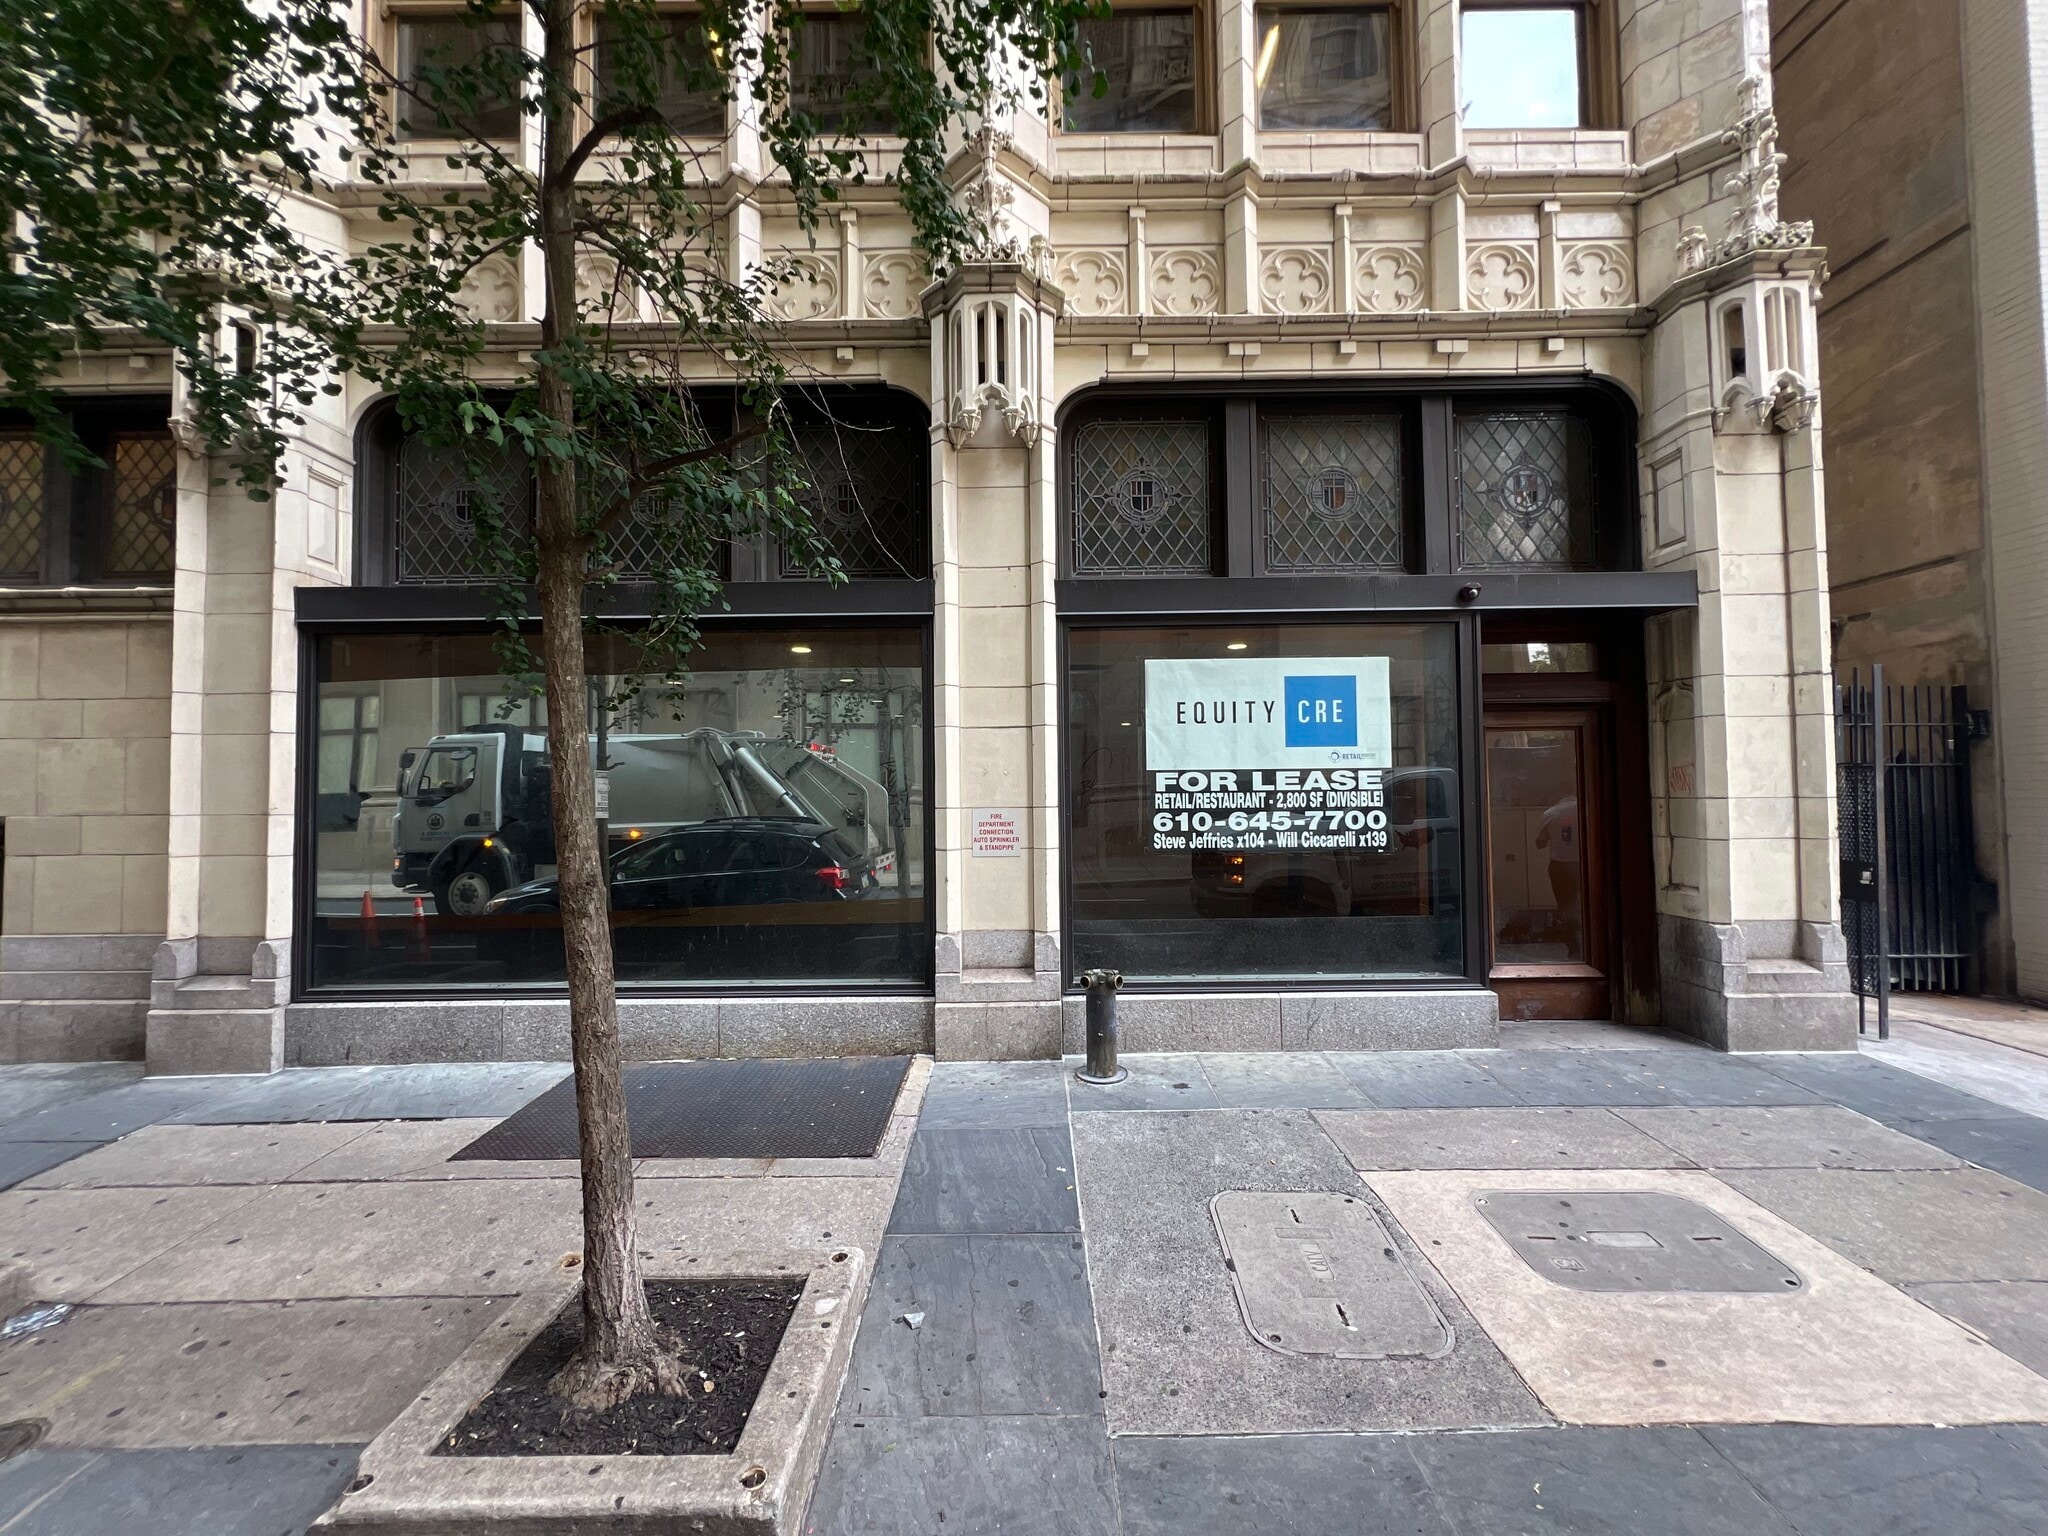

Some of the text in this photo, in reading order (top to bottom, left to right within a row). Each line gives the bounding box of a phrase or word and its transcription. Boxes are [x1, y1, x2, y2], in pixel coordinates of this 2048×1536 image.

[1176, 699, 1343, 724] EQUITY CRE
[1342, 752, 1361, 760] RETAIL
[1155, 770, 1383, 792] FOR LEASE
[1155, 792, 1266, 809] RETAIL/RESTAURANT
[1276, 791, 1307, 809] 2,800
[1309, 791, 1323, 807] SF
[1326, 790, 1384, 808] (DIVISIBLE)
[1153, 810, 1387, 832] 610-645-7700
[1153, 832, 1186, 849] Steve
[1189, 832, 1234, 849] Jeffries
[1236, 832, 1265, 848] x104
[1276, 831, 1298, 848] Will
[1301, 831, 1356, 848] Ciccarelli
[1359, 830, 1387, 847] x139
